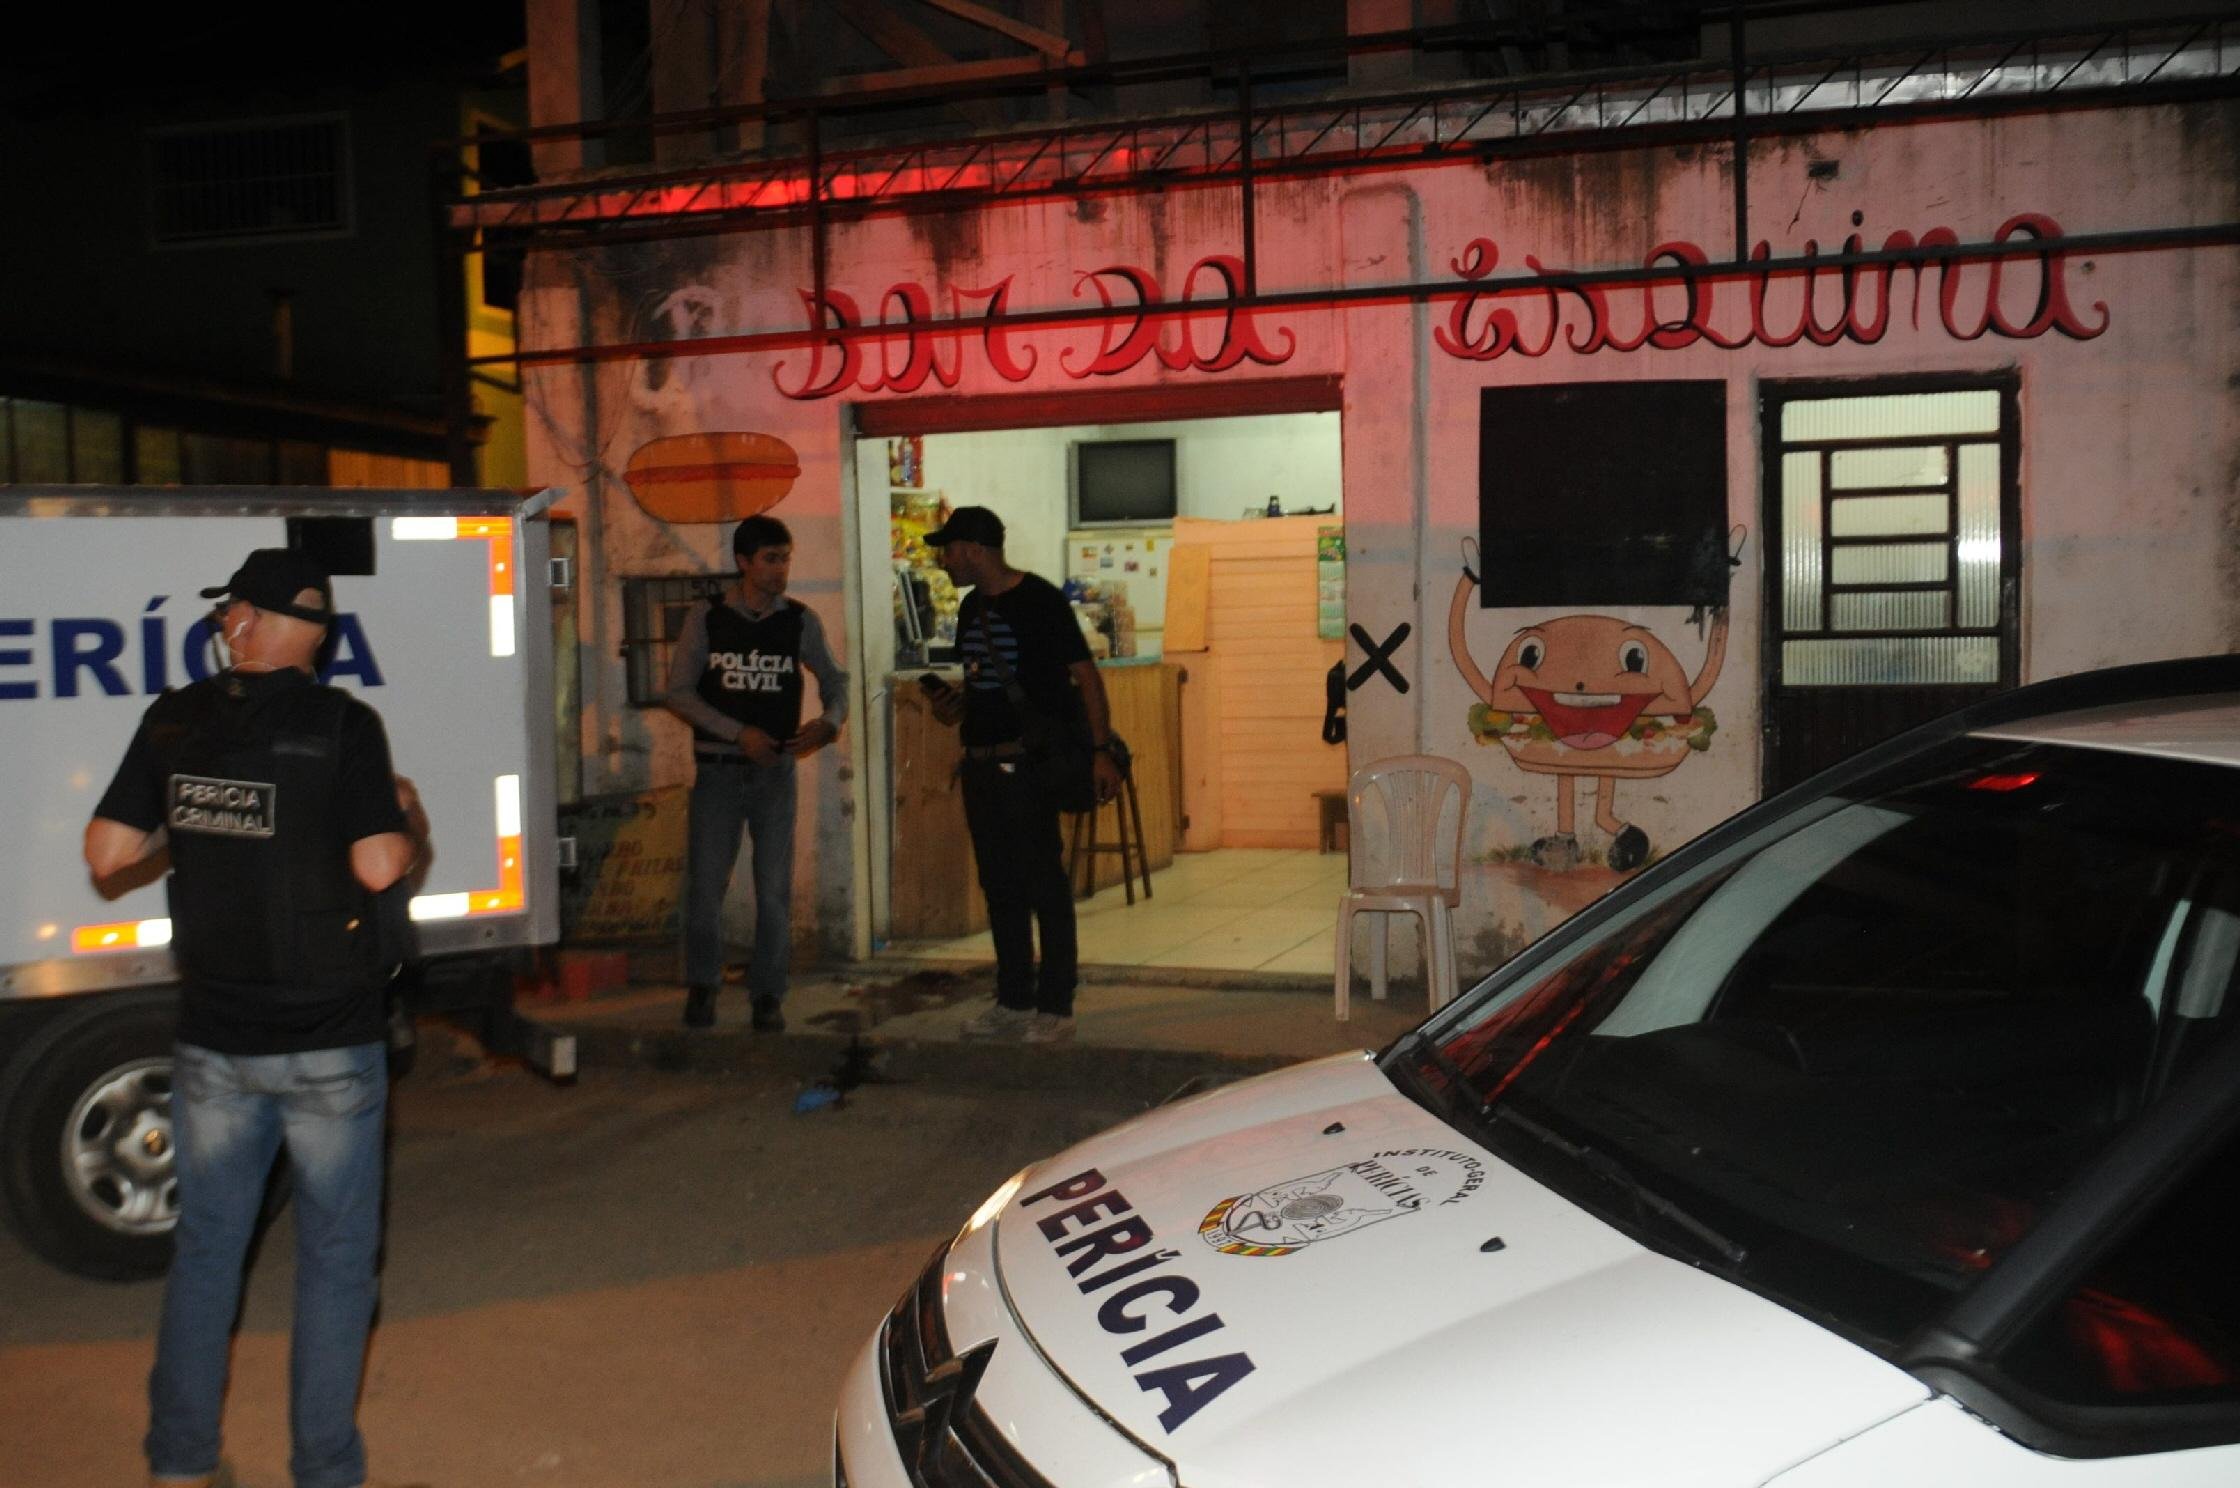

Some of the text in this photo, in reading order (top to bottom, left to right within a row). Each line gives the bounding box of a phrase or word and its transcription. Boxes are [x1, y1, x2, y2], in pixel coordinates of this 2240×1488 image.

[708, 648, 795, 673] POLÍCIA
[722, 670, 783, 692] CIVIL
[1415, 1166, 1438, 1177] DE
[1020, 1167, 1257, 1435] PERÍCIA
